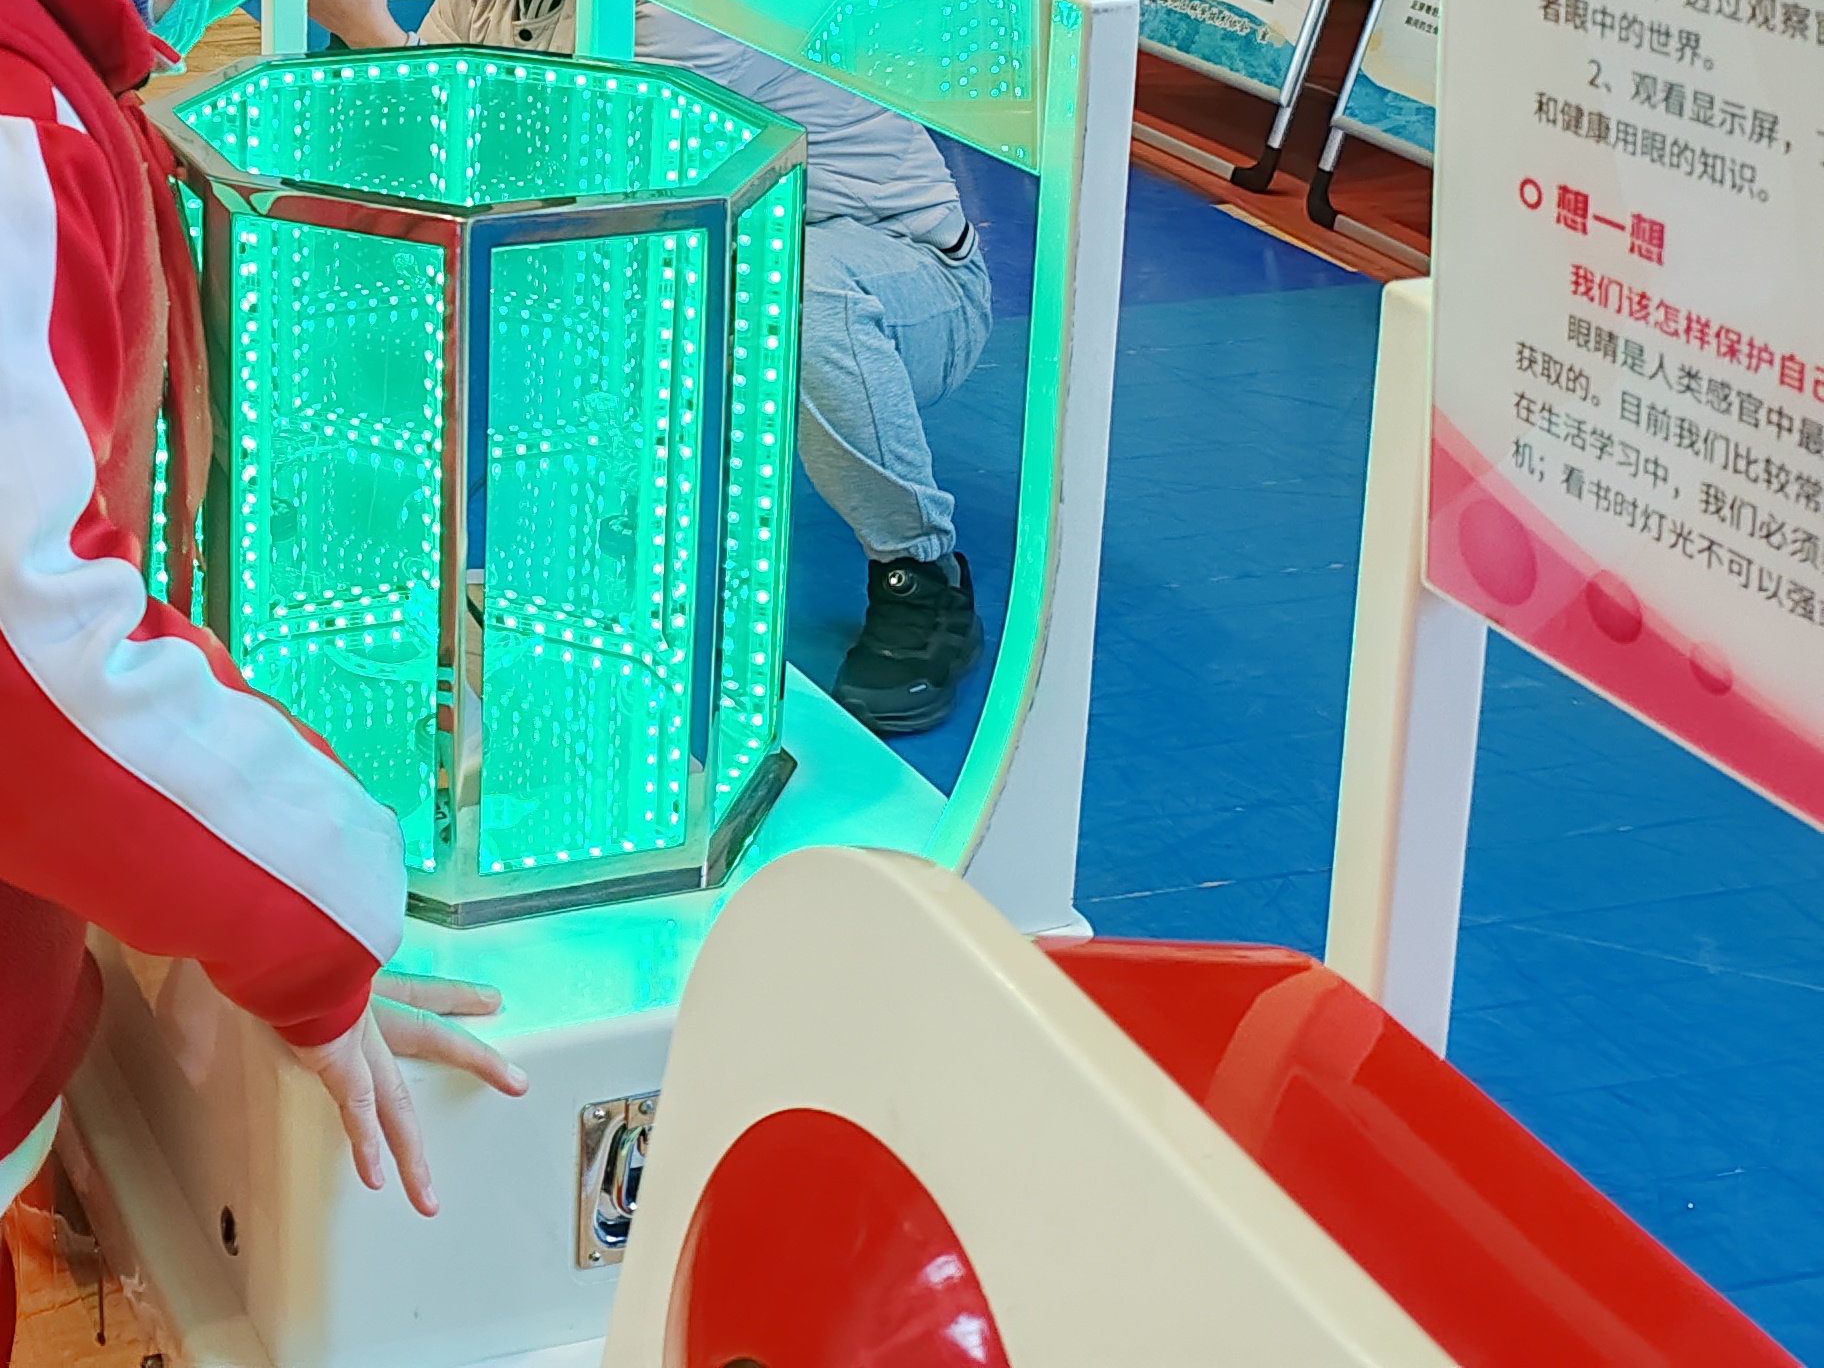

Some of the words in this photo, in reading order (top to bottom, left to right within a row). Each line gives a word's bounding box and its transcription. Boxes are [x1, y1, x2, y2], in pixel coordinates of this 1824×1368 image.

[1532, 89, 1771, 205] 和健康用眼的知识。
[1586, 58, 1824, 167] 2、观看显示屏，
[1554, 182, 1666, 267] 想一想
[1513, 338, 1824, 514] 获取的。目前我们比较常
[1566, 314, 1824, 460] 眼睛是人类感官中最
[1511, 438, 1824, 629] 机；看书时灯光不可以强
